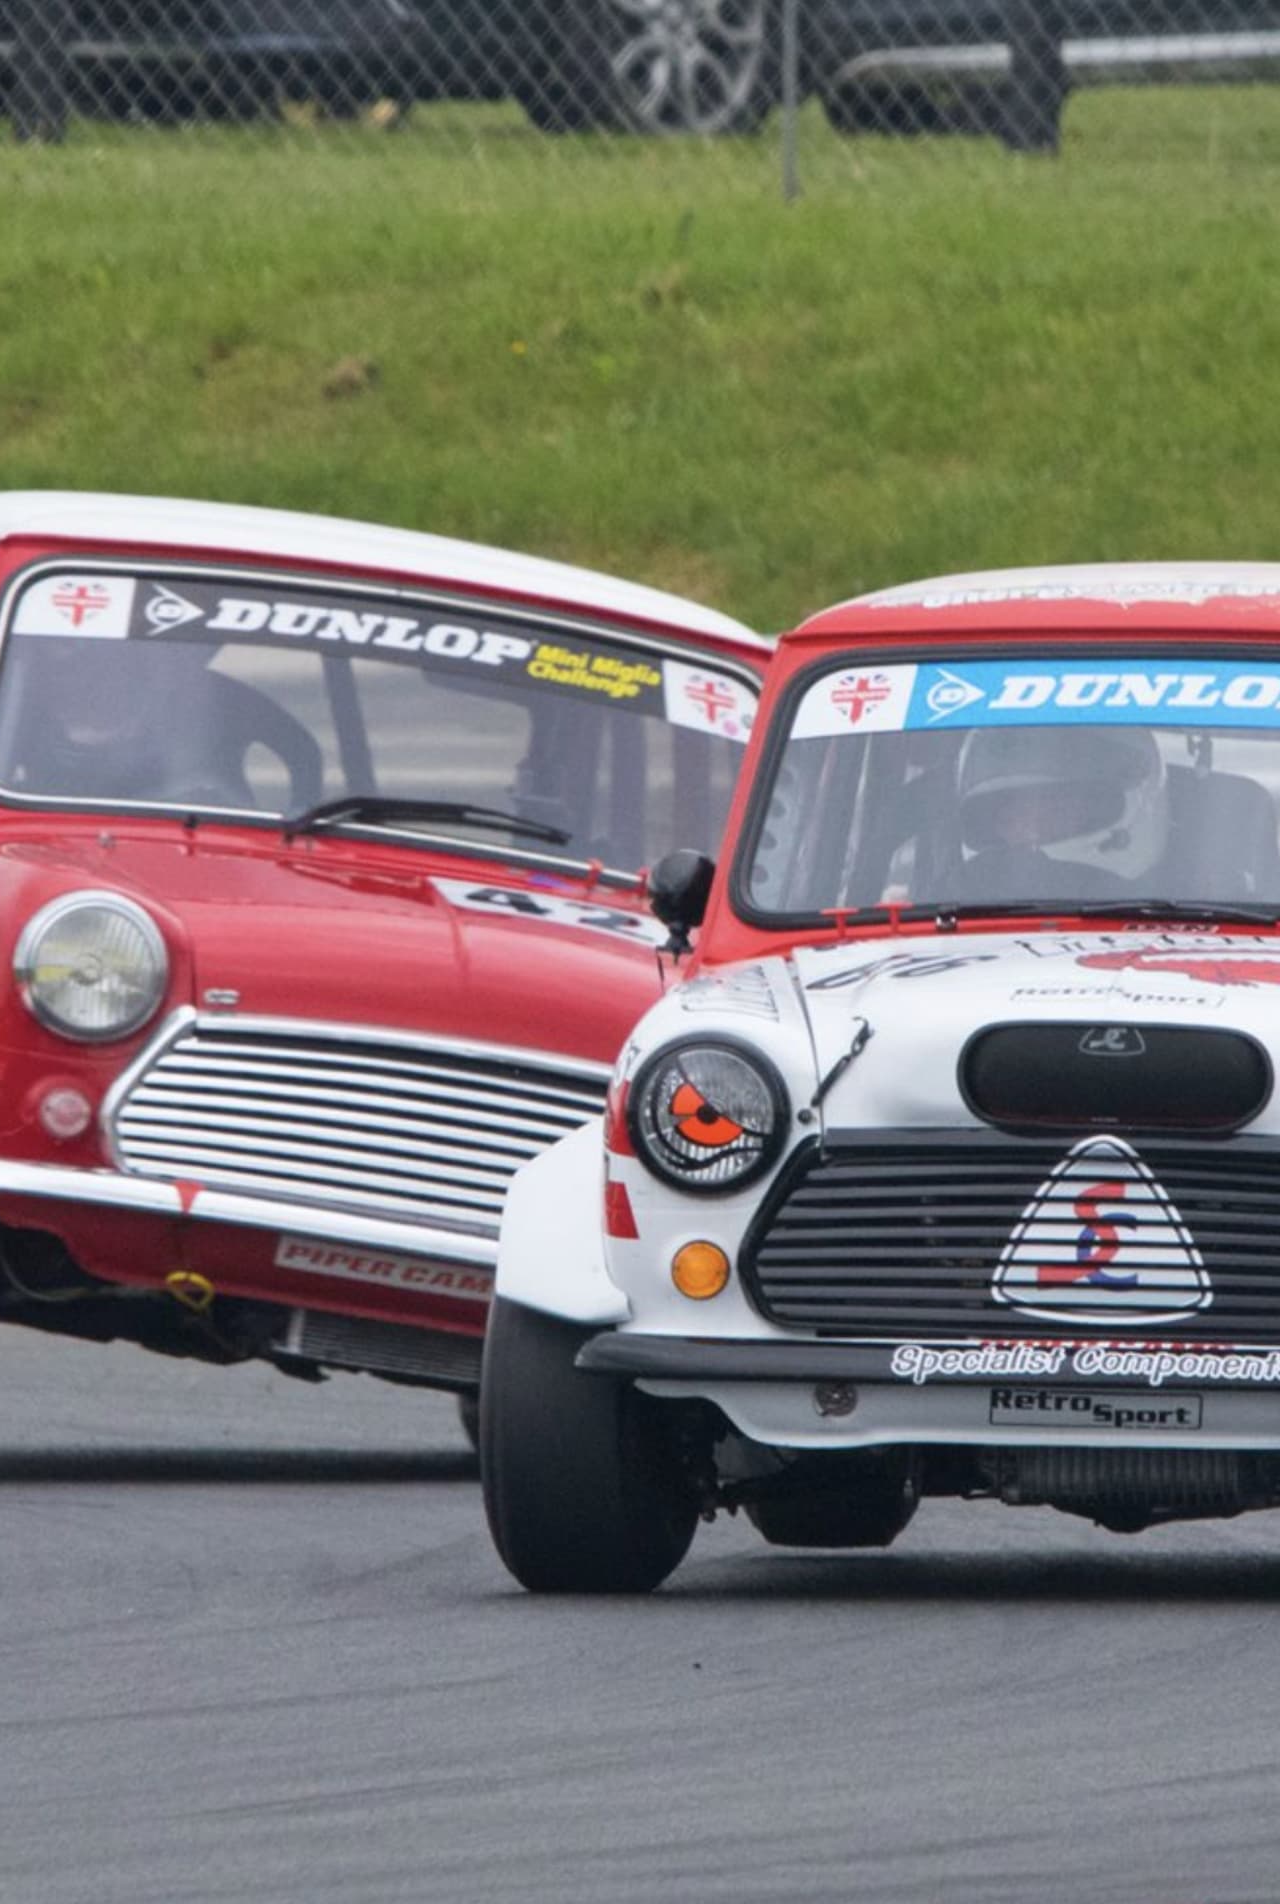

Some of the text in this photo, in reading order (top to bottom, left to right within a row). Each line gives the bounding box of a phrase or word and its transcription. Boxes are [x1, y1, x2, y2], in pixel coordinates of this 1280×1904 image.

[206, 597, 532, 666] DUNLOP
[526, 659, 641, 699] Challenge
[535, 644, 662, 687] Mini Miglia
[464, 887, 656, 943] 42
[284, 1244, 396, 1277] PIPER
[891, 1345, 1066, 1384] Specialist
[990, 1390, 1192, 1427] Retro Sport
